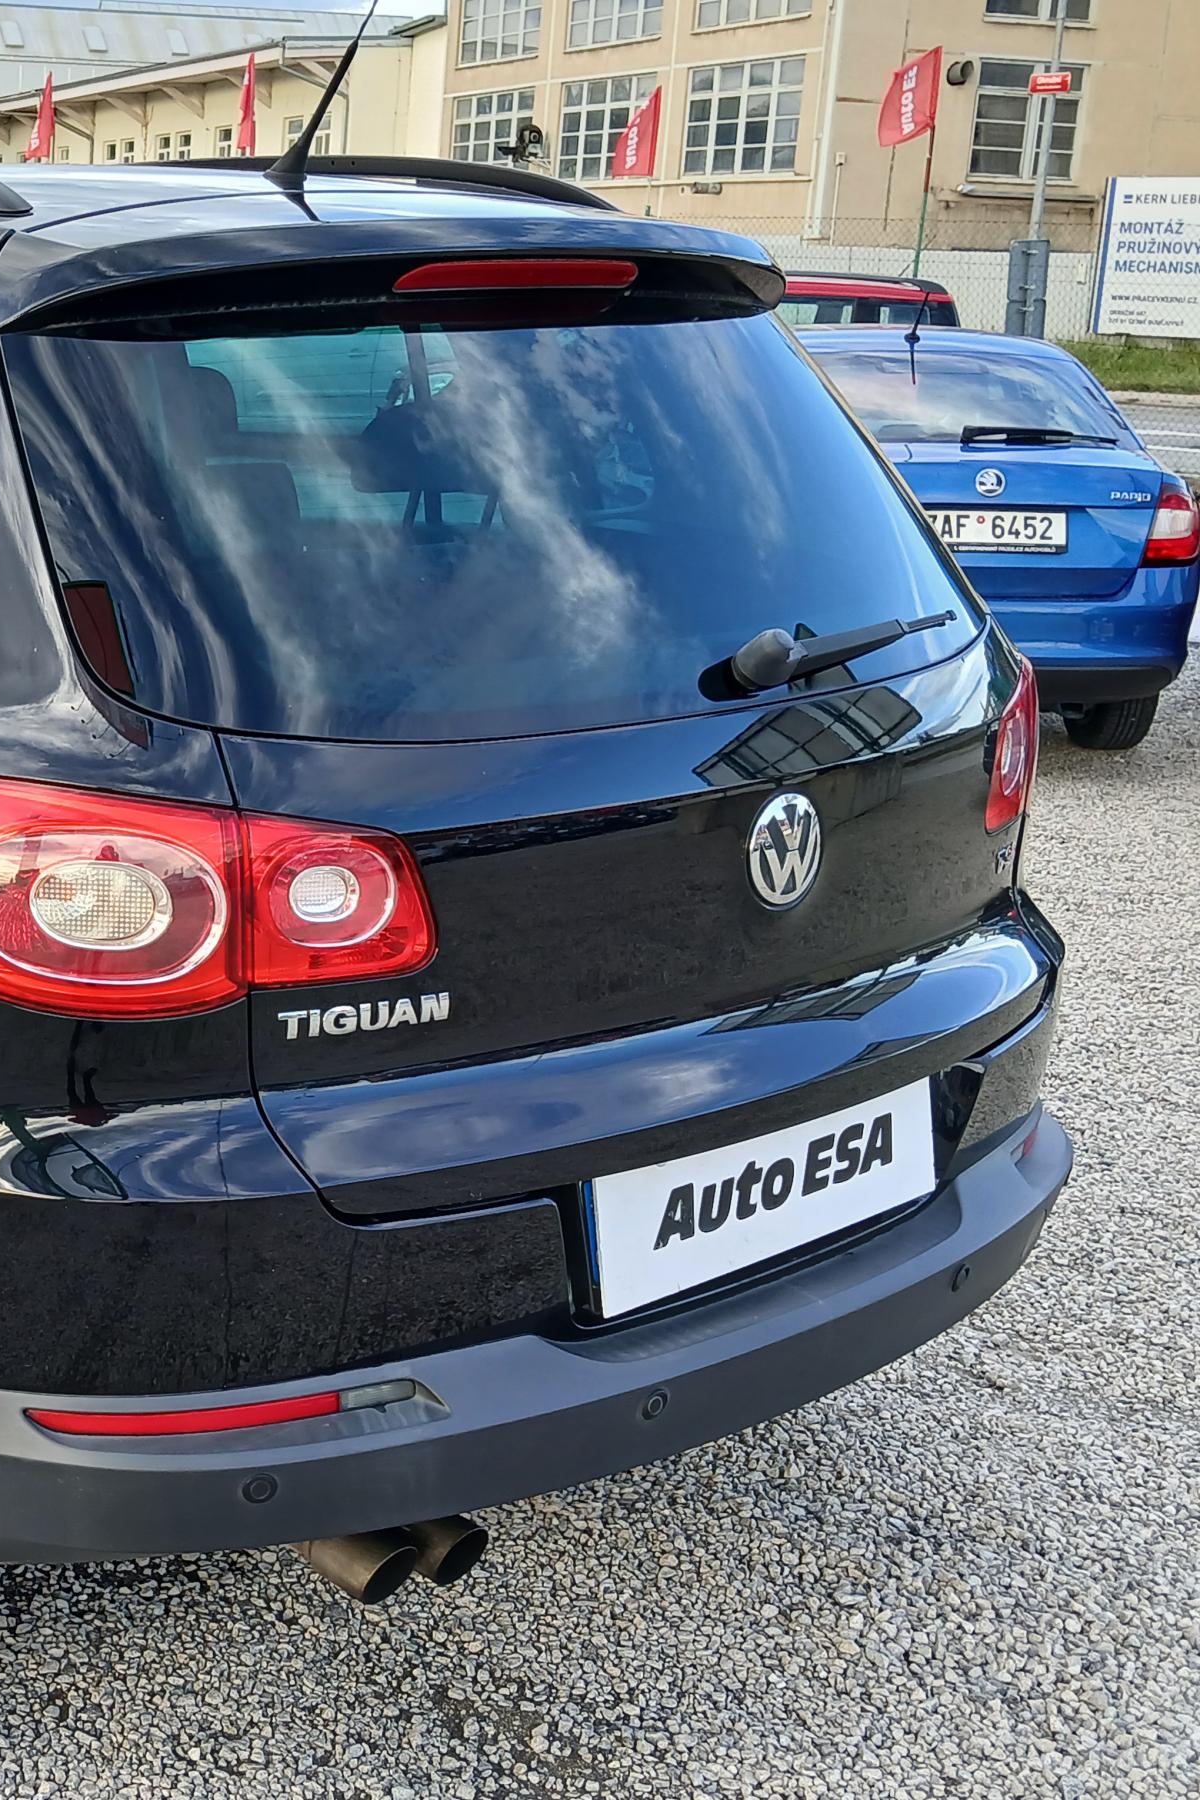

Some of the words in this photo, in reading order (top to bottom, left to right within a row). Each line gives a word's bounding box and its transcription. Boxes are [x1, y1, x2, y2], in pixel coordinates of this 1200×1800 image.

[1135, 193, 1167, 204] KERN
[1170, 194, 1200, 205] LIEB
[1119, 218, 1185, 235] MONTÁŽ
[991, 515, 1053, 541] 6452
[277, 991, 450, 1040] TIGUAN
[653, 1156, 795, 1250] Auto
[801, 1112, 893, 1197] ESA
